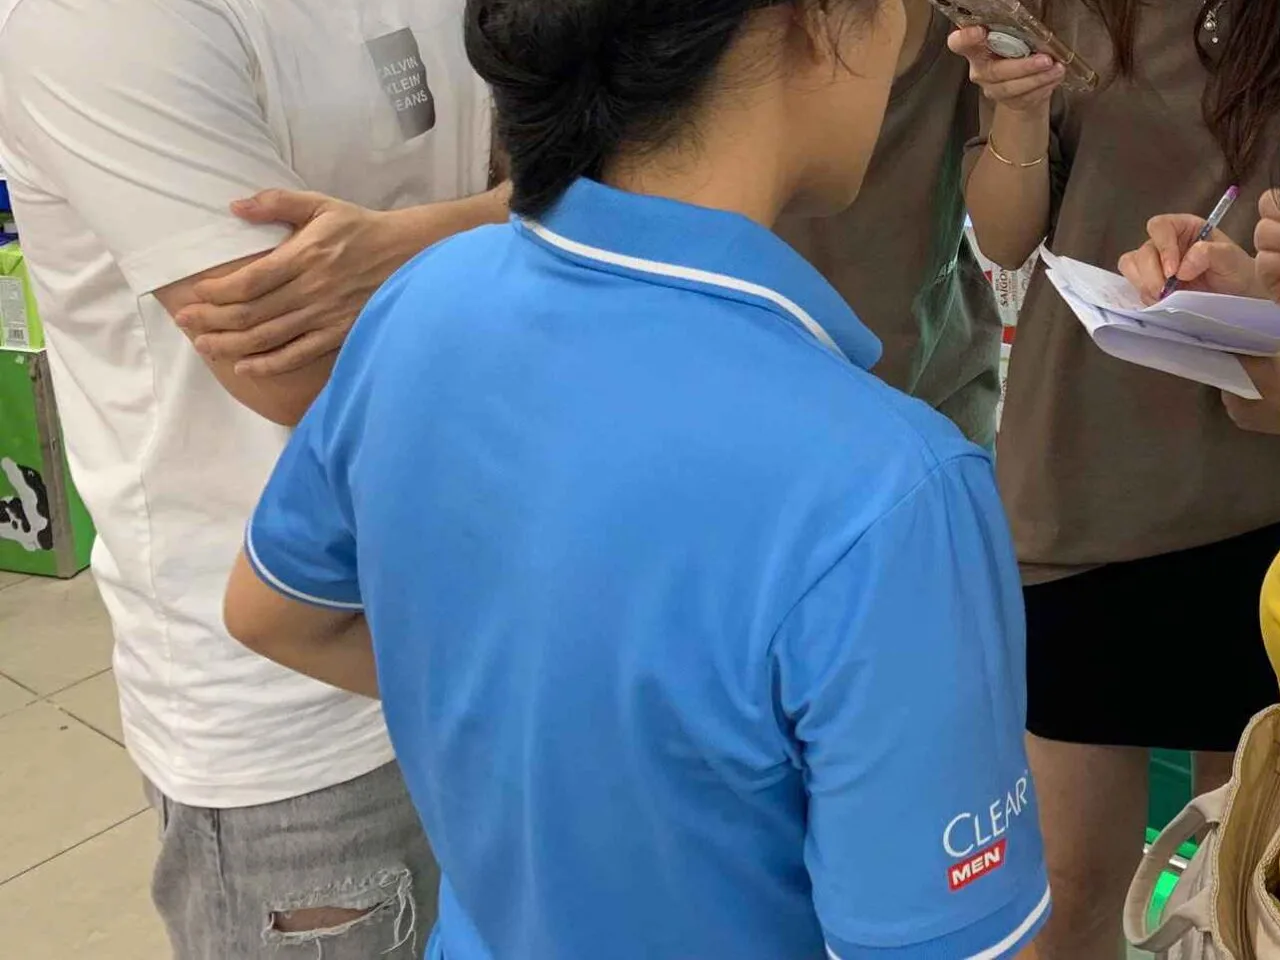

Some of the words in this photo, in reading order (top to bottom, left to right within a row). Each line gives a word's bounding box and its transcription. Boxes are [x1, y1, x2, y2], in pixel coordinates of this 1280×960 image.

[396, 89, 428, 111] EANS
[943, 777, 1028, 858] CLEAR
[951, 846, 1001, 886] MEN
